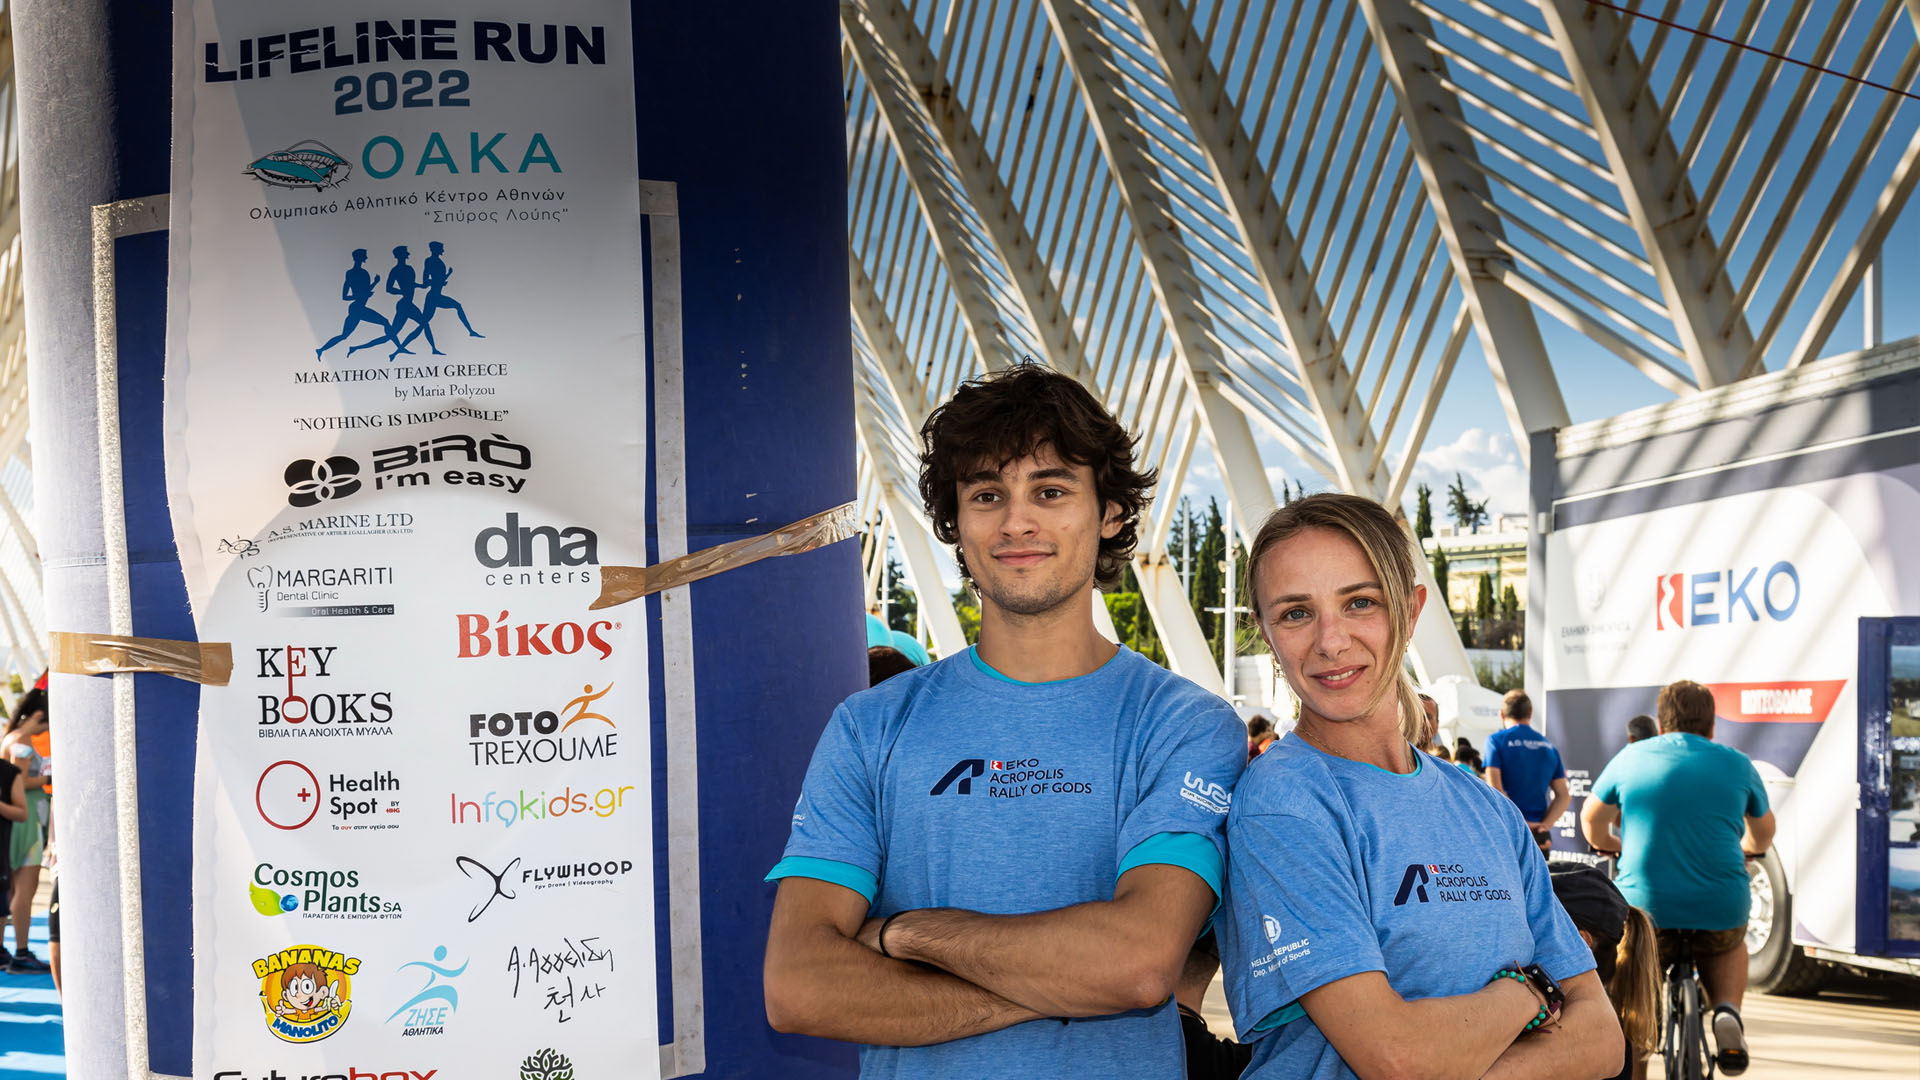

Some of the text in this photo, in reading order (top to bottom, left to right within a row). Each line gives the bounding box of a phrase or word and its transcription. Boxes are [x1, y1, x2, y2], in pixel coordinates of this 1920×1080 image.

[205, 19, 606, 83] LIFELINE RUN
[334, 69, 470, 116] 2022
[362, 132, 562, 179] ΟΑΚΑ
[249, 188, 565, 220] Ολυμπιακό Αθλητικό Κέντρο Αθηνών
[294, 363, 508, 384] MARATHON TEAM GREECE
[394, 384, 495, 401] by Maria Polyzou
[388, 414, 402, 427] IS
[443, 470, 526, 494] easy
[268, 513, 413, 538] A.S. MARINE LTD
[475, 512, 599, 569] dna
[277, 567, 393, 588] MARGARITI
[486, 570, 590, 585] centers
[277, 591, 339, 601] Dental Clinic
[1691, 560, 1800, 627] EKO
[312, 606, 393, 616] Oral Health & Care
[456, 609, 613, 661] Βίκος
[256, 645, 337, 677] KEY
[258, 692, 393, 725] BOOKS
[258, 726, 393, 738] ΒΙΒΛΙΑ ΓΙΑ ΑΝΟΙΧΤΑ ΜΥΑΛΑ
[470, 711, 559, 738] FOTO
[469, 733, 617, 766] TREXOUME
[1006, 758, 1039, 770] EKO
[329, 771, 400, 792] Health
[989, 768, 1064, 784] ACROPOLIS
[989, 782, 1092, 798] RALLY OF GODS
[329, 796, 378, 820] Spot
[451, 787, 634, 828] Infokids.gr
[254, 863, 359, 888] Cosmos
[522, 860, 632, 883] FLYWHOOP
[1438, 864, 1464, 874] EKO
[1435, 876, 1489, 888] ACROPOLIS
[303, 889, 402, 913] Plants SA
[1439, 889, 1512, 902] RALLY OF GODS
[252, 949, 361, 979] BANANAS
[272, 1015, 339, 1038] MANOLITO
[404, 1007, 448, 1027] ΖΗΣΕ
[402, 1026, 444, 1037] ΑΘΛΗΤΙΚΑ
